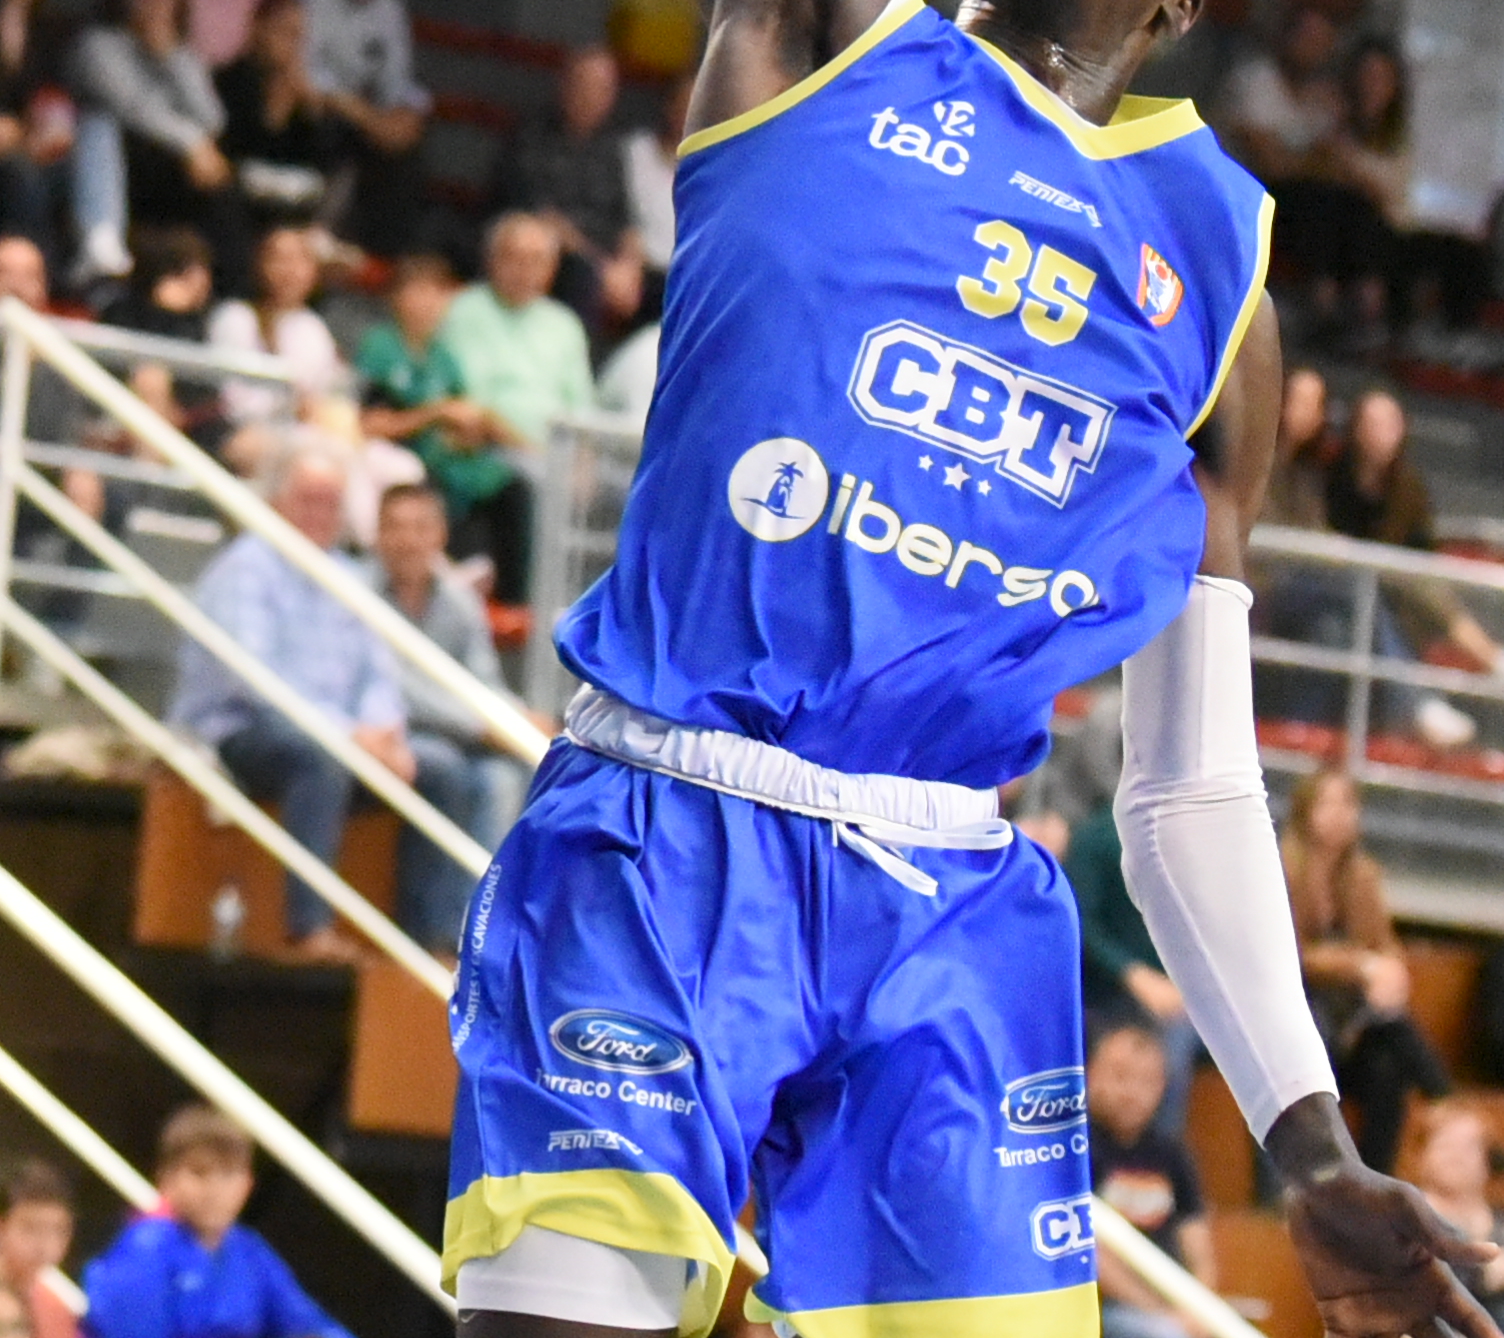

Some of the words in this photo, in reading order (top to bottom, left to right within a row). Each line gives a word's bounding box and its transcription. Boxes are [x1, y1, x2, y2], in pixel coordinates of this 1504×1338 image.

[868, 105, 971, 177] tac
[1007, 169, 1088, 215] PENTEX
[955, 219, 1098, 347] 35
[854, 325, 1110, 499] CBT
[827, 471, 1102, 618] iberso
[576, 1018, 658, 1063] Ford
[618, 1080, 698, 1117] Center
[1016, 1082, 1087, 1123] Ford
[547, 1129, 622, 1153] PENTEX
